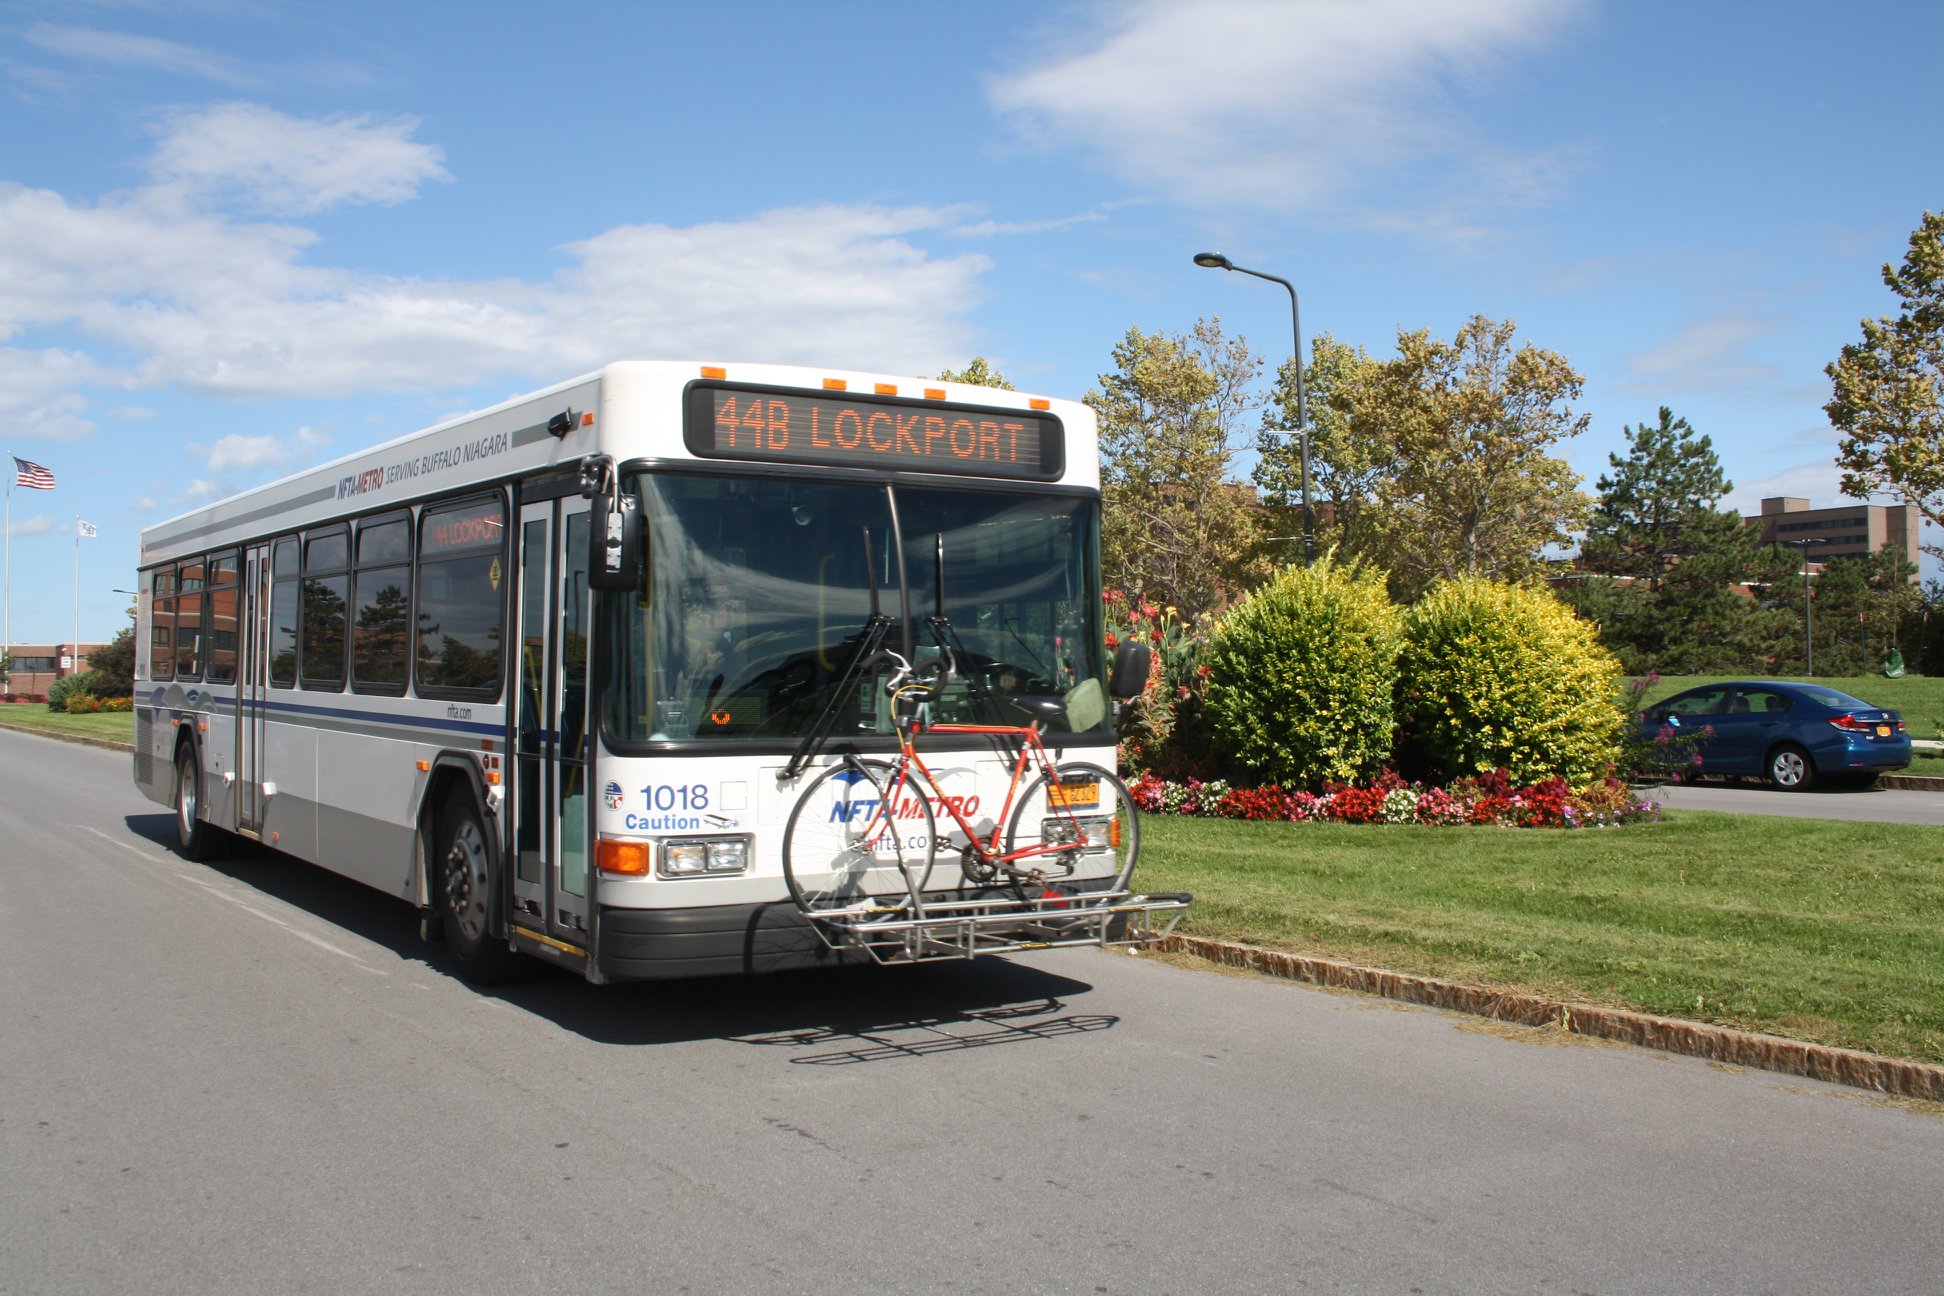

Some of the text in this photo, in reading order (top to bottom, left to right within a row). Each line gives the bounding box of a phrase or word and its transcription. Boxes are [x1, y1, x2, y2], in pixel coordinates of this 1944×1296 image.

[716, 397, 1025, 462] 44B LOCKPORT
[337, 432, 508, 501] NFTA-METRO SERVING BUFFALO NIAGARA
[447, 704, 472, 719] nfta.com
[640, 784, 709, 811] 1018
[625, 813, 700, 830] Caution
